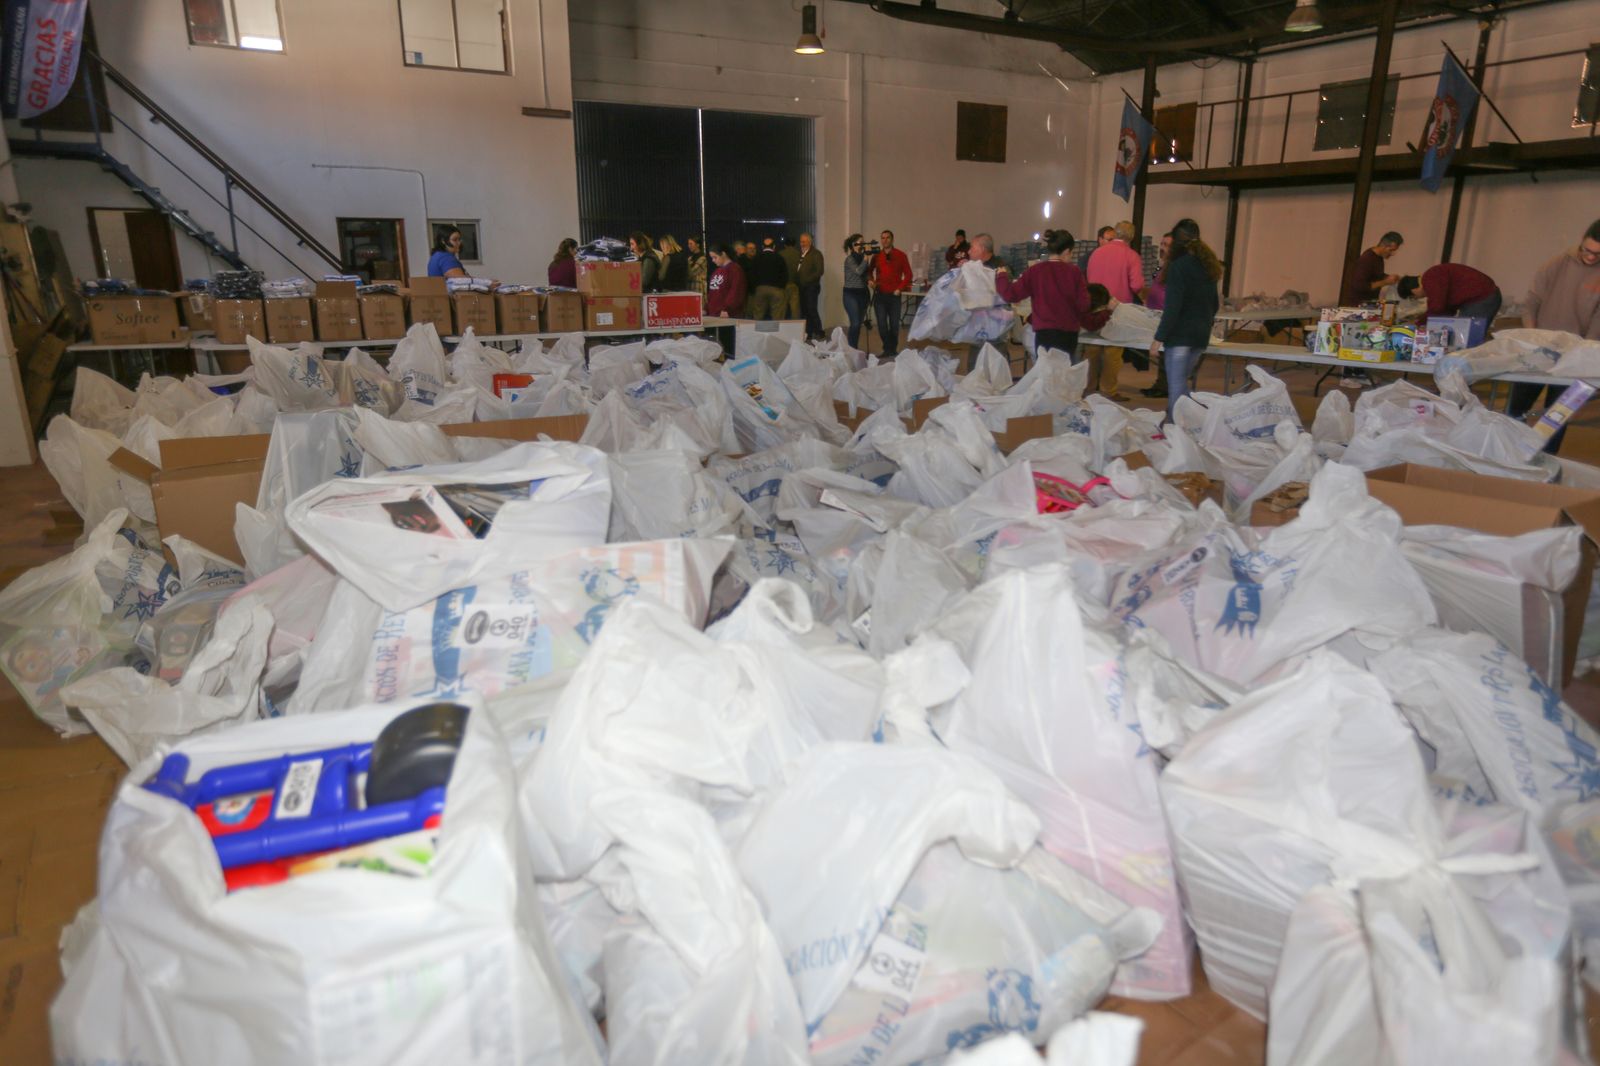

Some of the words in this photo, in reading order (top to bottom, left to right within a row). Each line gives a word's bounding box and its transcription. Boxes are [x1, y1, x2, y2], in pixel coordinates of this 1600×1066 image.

[27, 17, 57, 110] GRACIAS
[58, 31, 75, 86] CHICLANA
[116, 312, 160, 326] Softee
